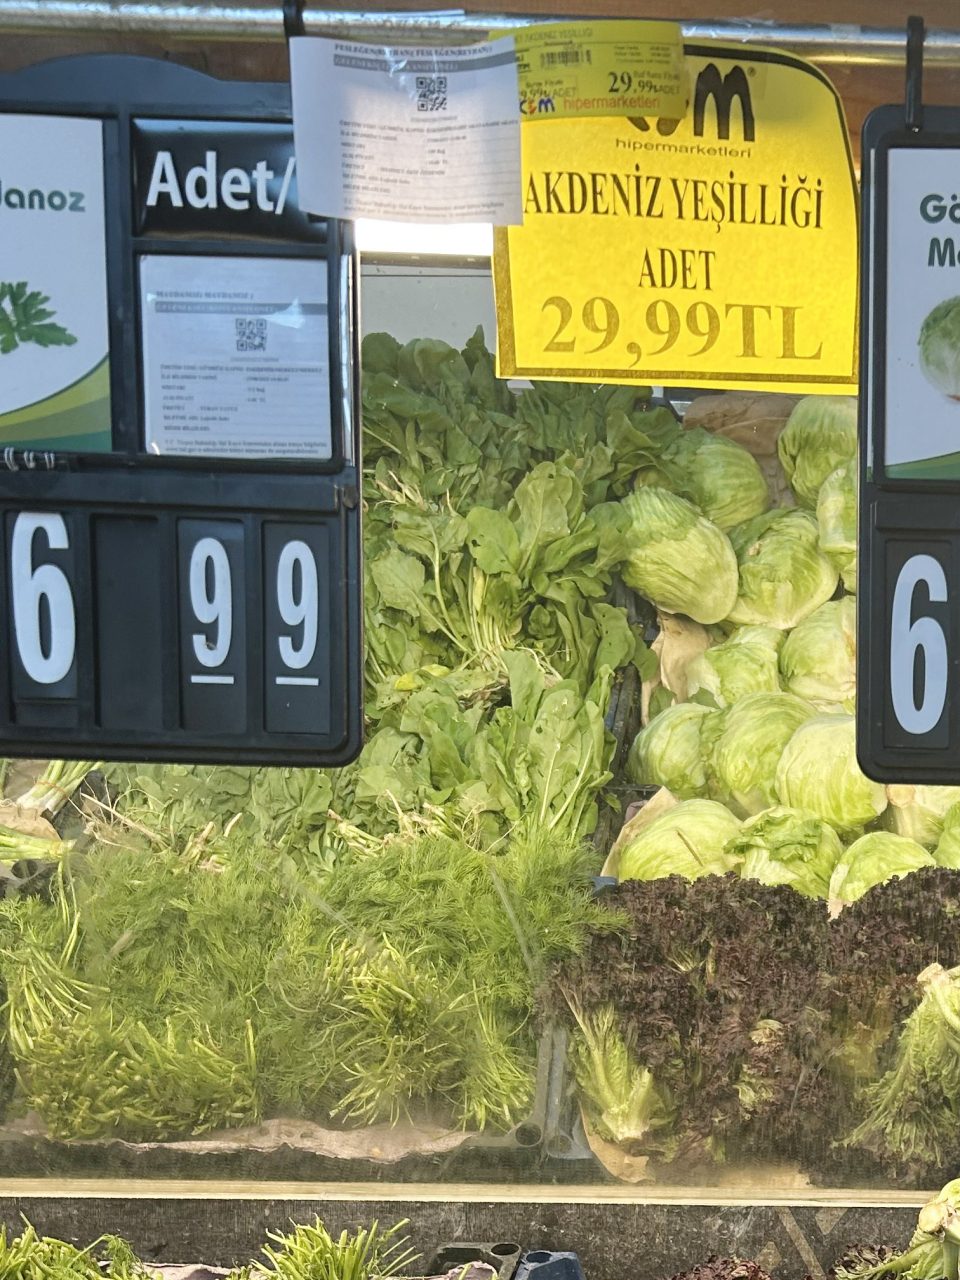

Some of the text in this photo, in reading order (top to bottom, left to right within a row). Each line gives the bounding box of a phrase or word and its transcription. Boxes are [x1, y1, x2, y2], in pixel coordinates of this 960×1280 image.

[615, 138, 752, 158] hipermarketleri
[146, 151, 296, 215] Adet/
[524, 163, 825, 234] AKDENİZ YEŞİLLİĞİ
[638, 248, 716, 291] ADET
[541, 296, 824, 368] 29,99TL
